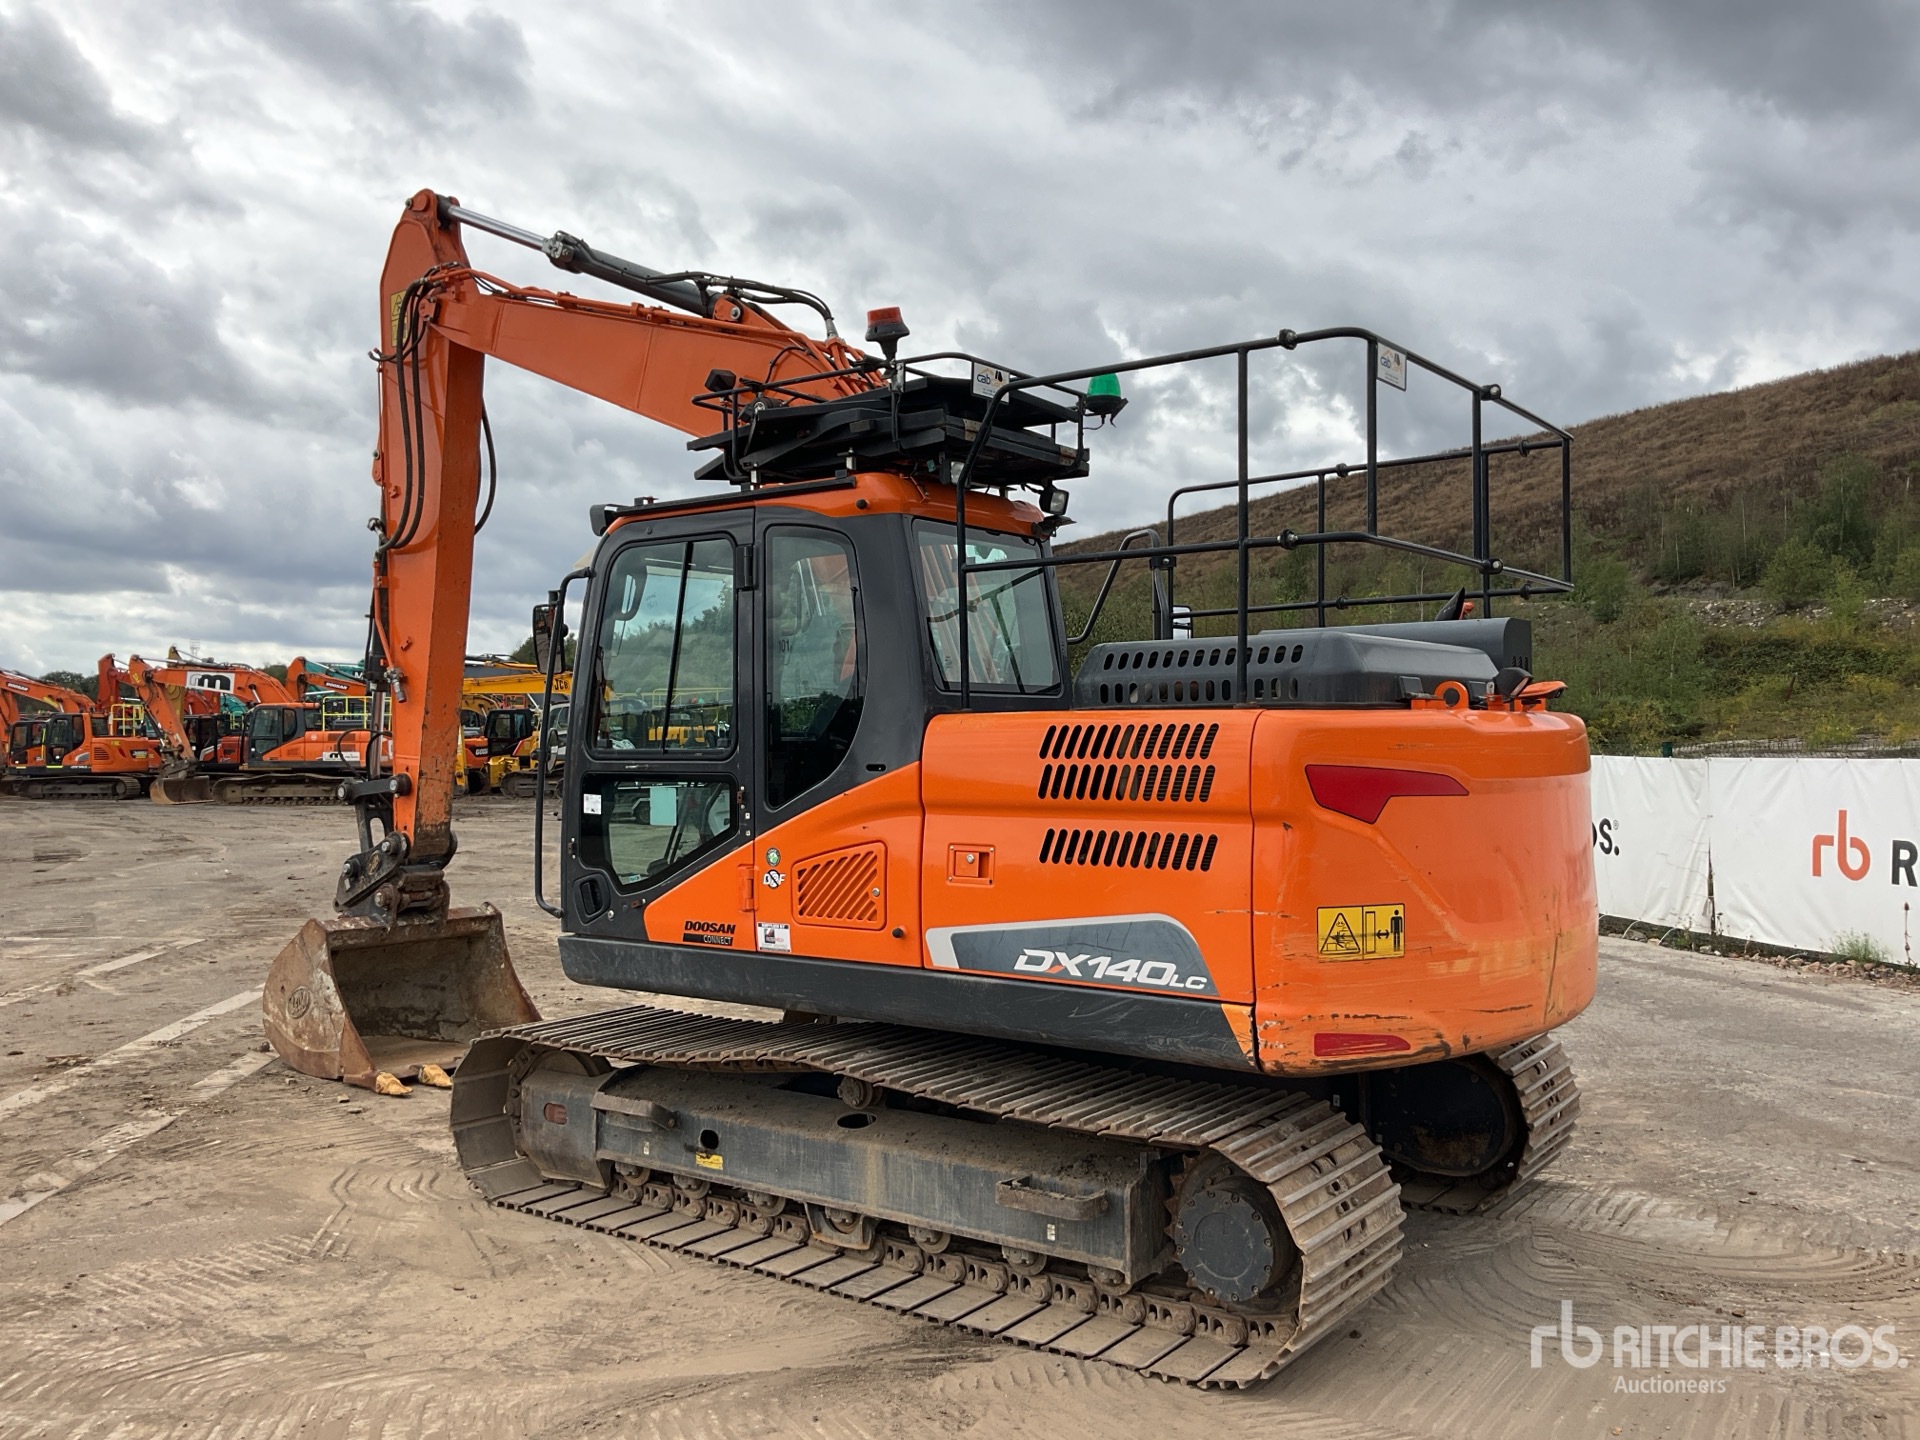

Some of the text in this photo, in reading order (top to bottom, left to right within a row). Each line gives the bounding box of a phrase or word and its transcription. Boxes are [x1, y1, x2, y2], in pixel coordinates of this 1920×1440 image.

[554, 678, 568, 691] JCB
[684, 920, 736, 934] DOOSAN
[703, 934, 732, 945] CONNECT
